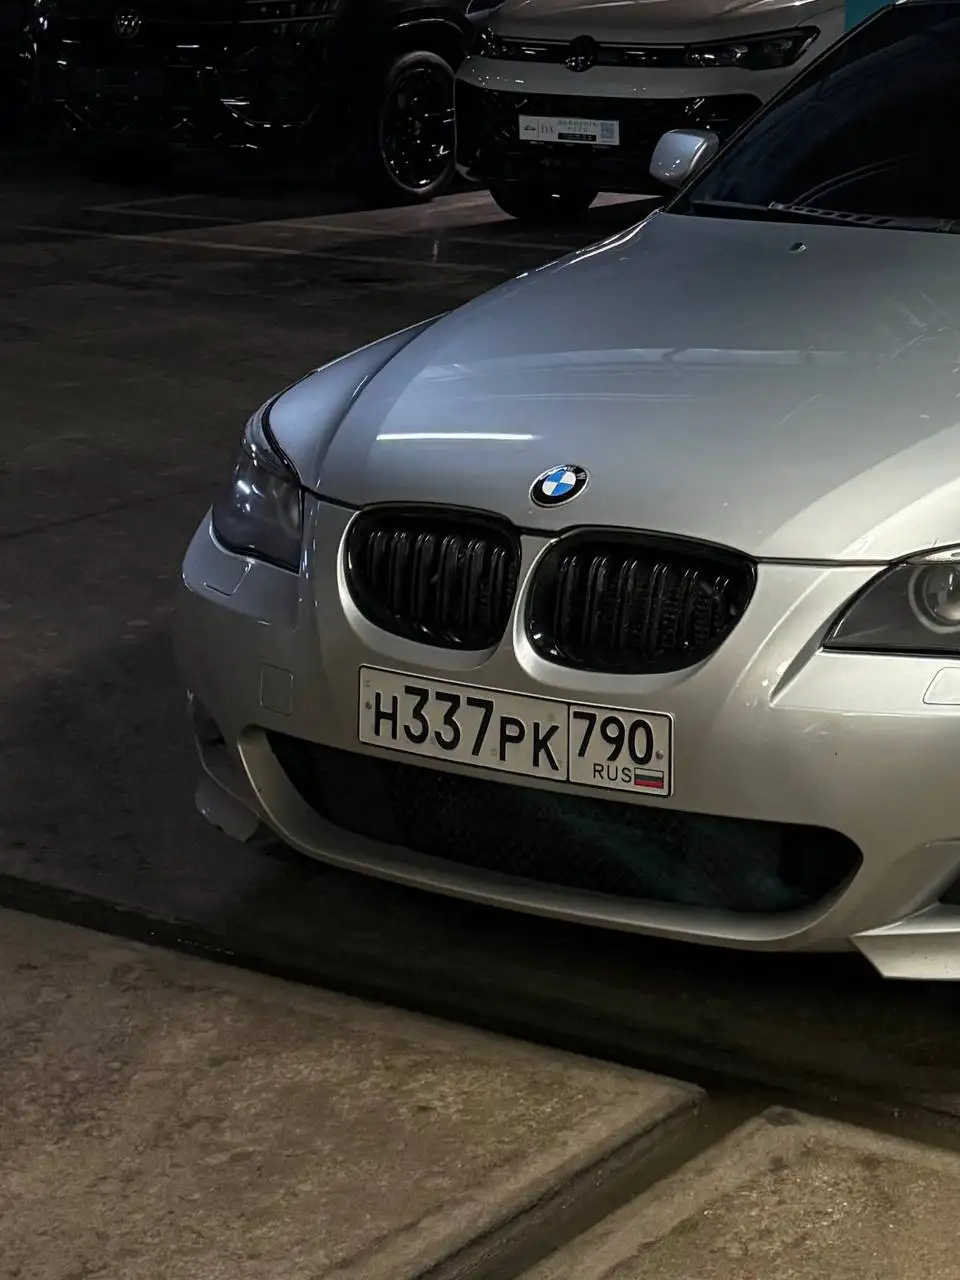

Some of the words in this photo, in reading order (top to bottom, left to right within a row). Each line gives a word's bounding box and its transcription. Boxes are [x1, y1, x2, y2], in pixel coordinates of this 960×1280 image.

[374, 684, 561, 771] Н337РК
[573, 710, 654, 766] 790
[593, 763, 632, 784] RUS
